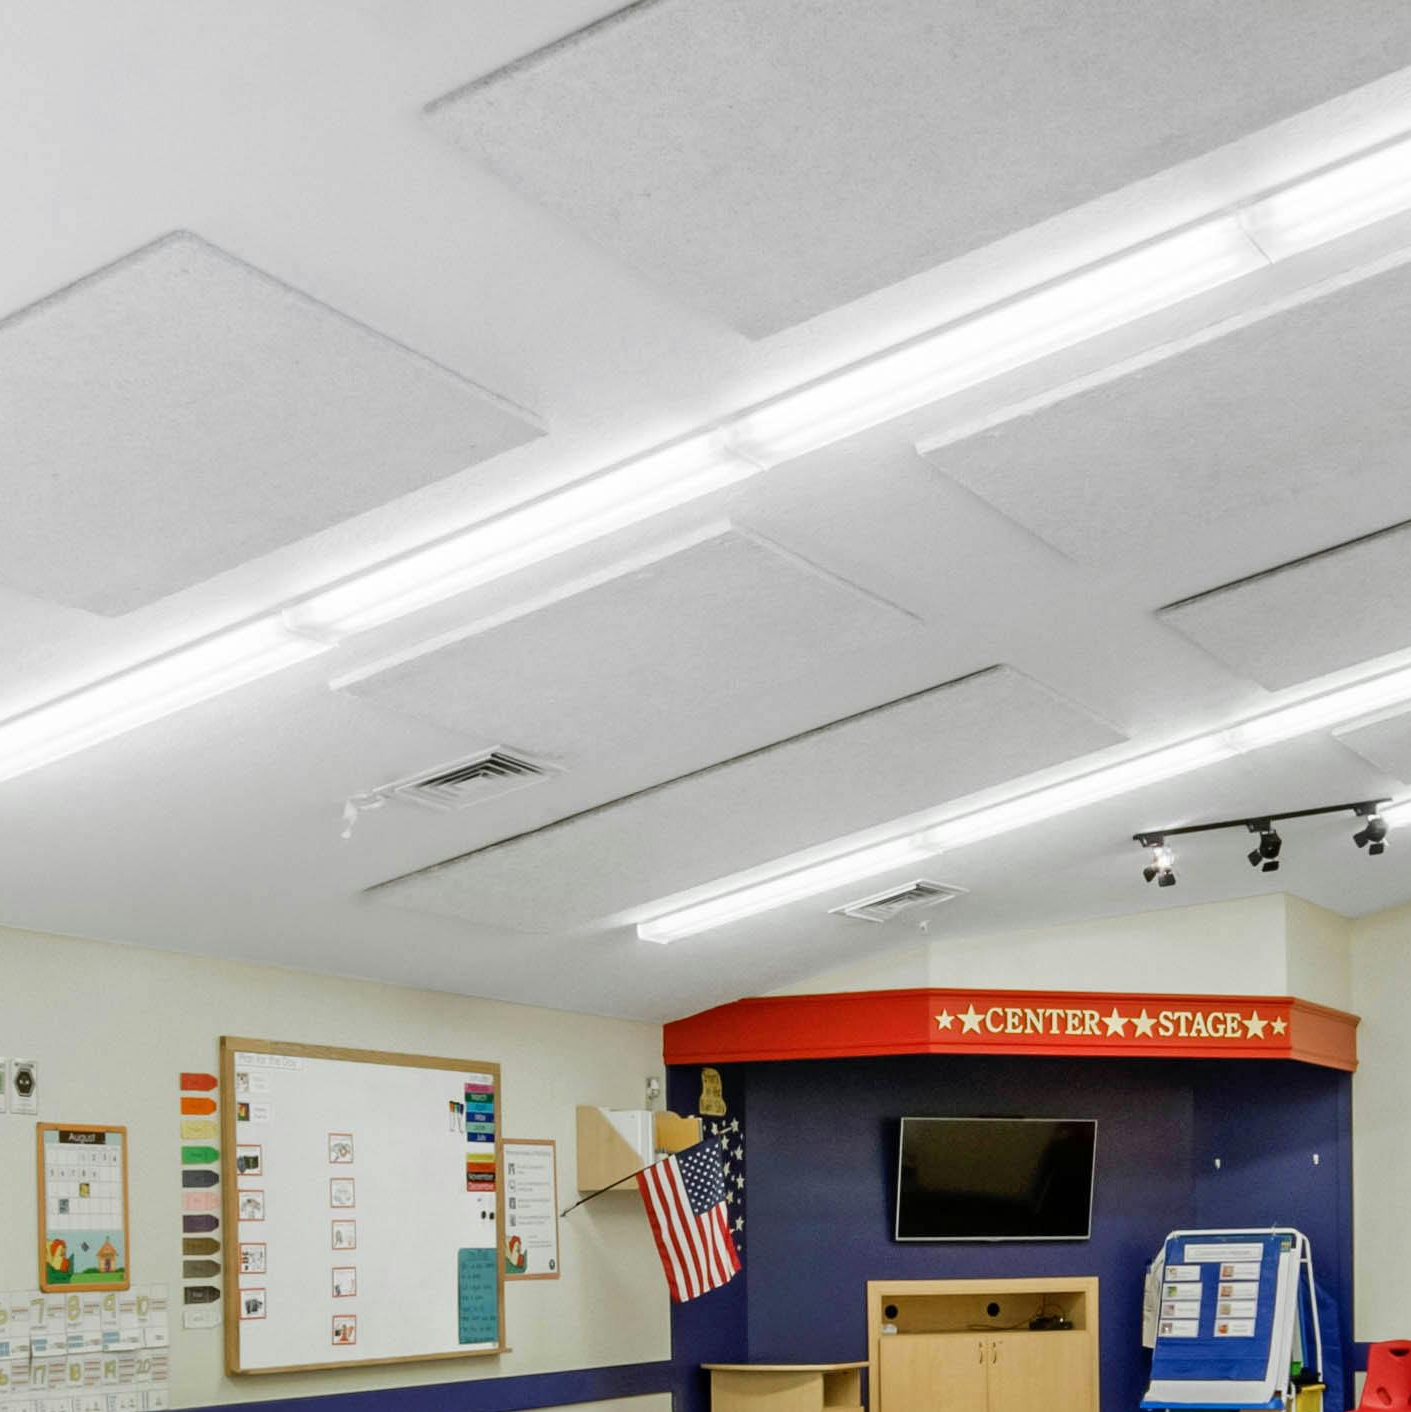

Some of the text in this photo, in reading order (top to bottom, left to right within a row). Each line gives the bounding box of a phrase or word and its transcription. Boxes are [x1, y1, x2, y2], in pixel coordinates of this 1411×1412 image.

[986, 1007, 1243, 1039] CENTER STAGE
[67, 1132, 97, 1144] August
[30, 1297, 45, 1324] 7
[67, 1295, 80, 1321] 8
[103, 1294, 117, 1319] 9
